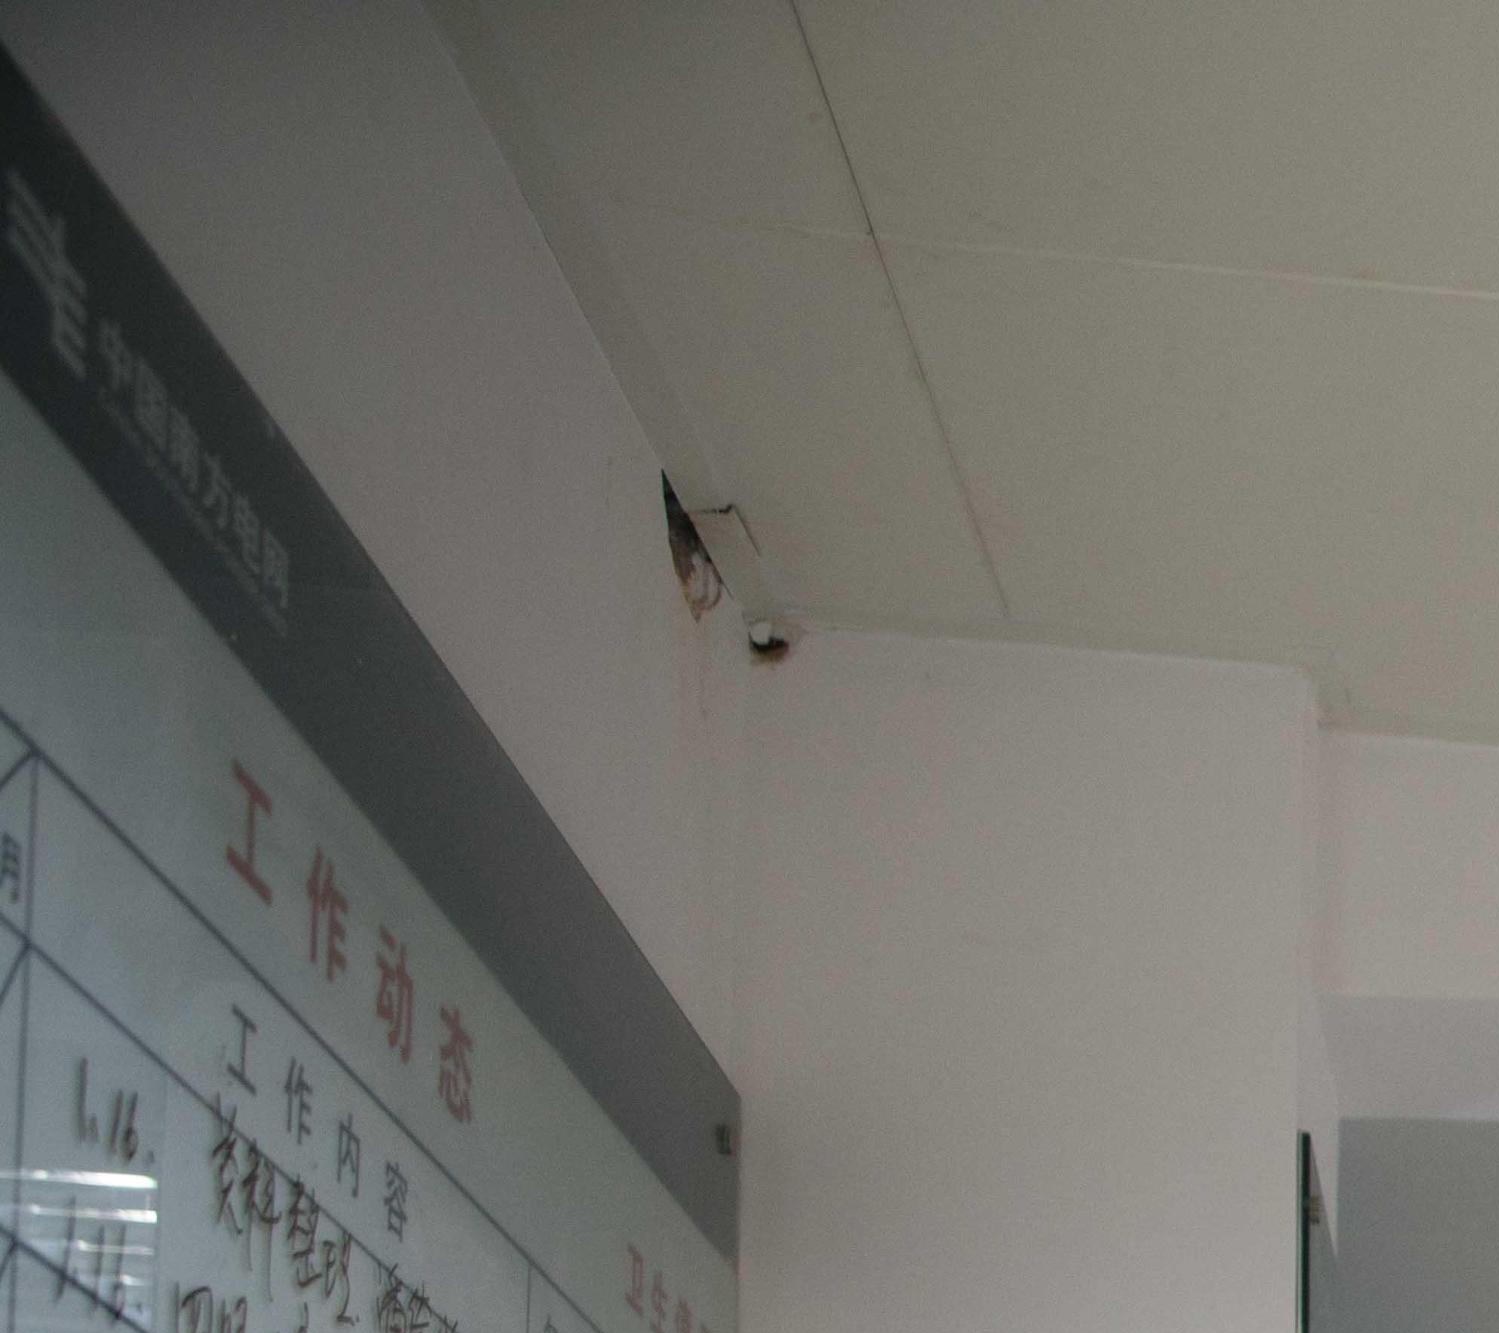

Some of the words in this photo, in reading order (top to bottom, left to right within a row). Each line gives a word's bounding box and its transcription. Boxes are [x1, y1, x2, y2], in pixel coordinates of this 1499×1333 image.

[228, 759, 476, 1126] 工作动态
[226, 1004, 408, 1242] 工作内容
